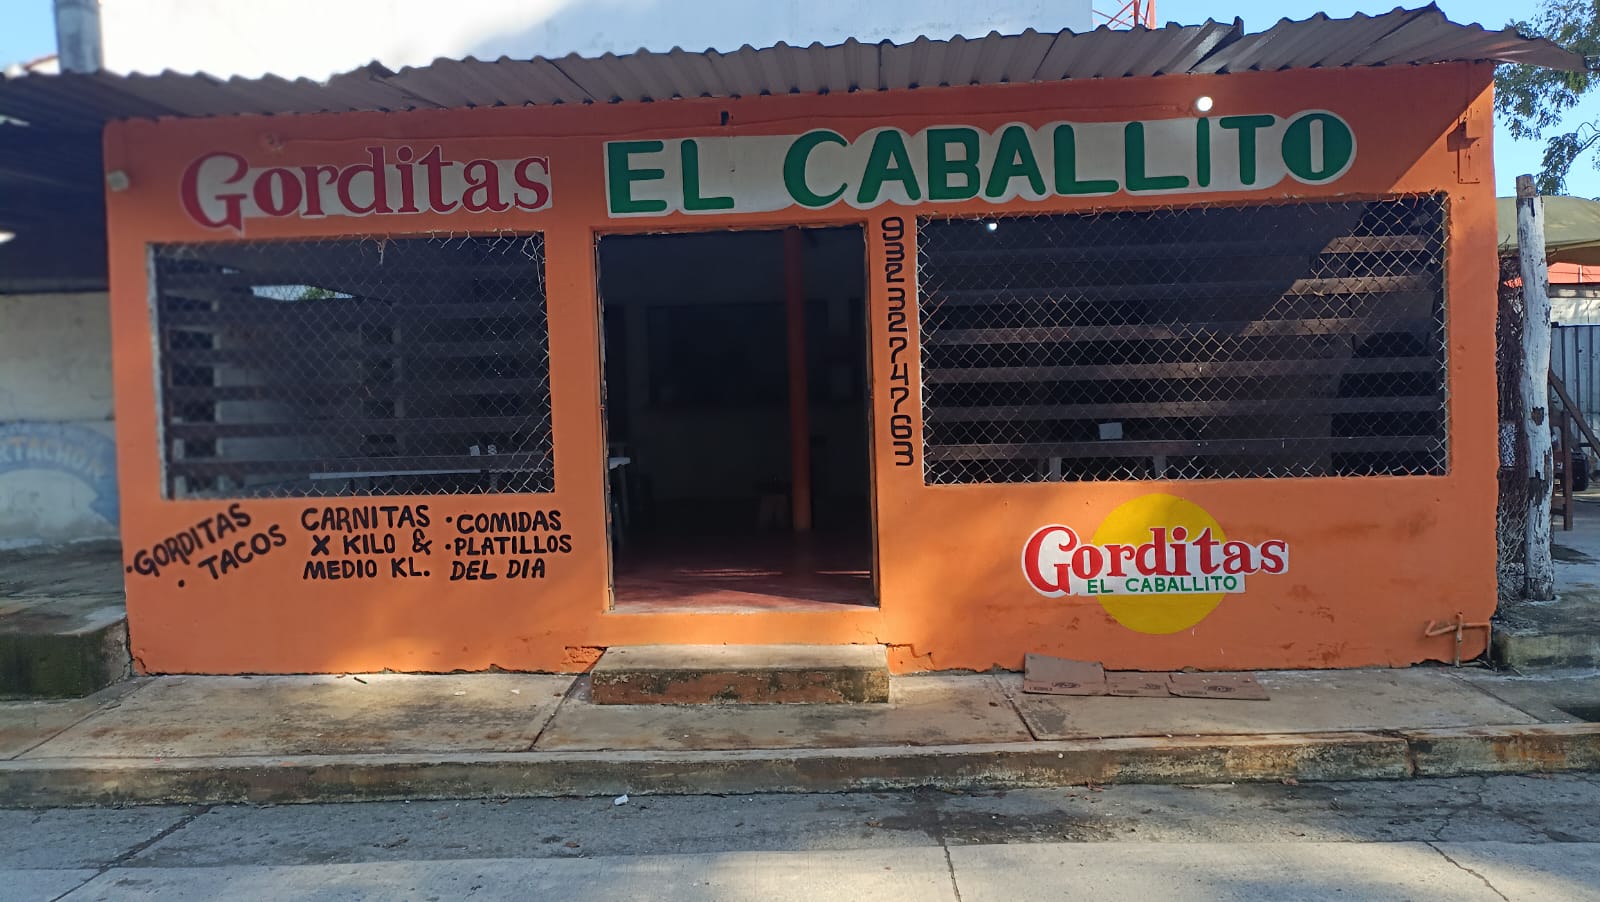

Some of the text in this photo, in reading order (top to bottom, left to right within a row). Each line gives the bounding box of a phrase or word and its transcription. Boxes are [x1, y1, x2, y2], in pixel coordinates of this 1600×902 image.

[608, 112, 1353, 213] EL CABALLITO
[181, 145, 550, 232] Gorditas
[881, 216, 914, 467] 9323274763
[301, 505, 430, 533] CARNITAS
[456, 510, 562, 534] COMIDAS
[133, 503, 251, 577] GORDITAS
[198, 524, 287, 580] TACOS
[310, 528, 432, 556] X KILO &
[454, 534, 572, 556] PLATILLOS
[303, 556, 431, 580] MEDIO KL.
[449, 558, 546, 581] DEL DIA
[1024, 526, 1286, 594] Gorditas
[1087, 576, 1237, 594] EL CABALLITO
